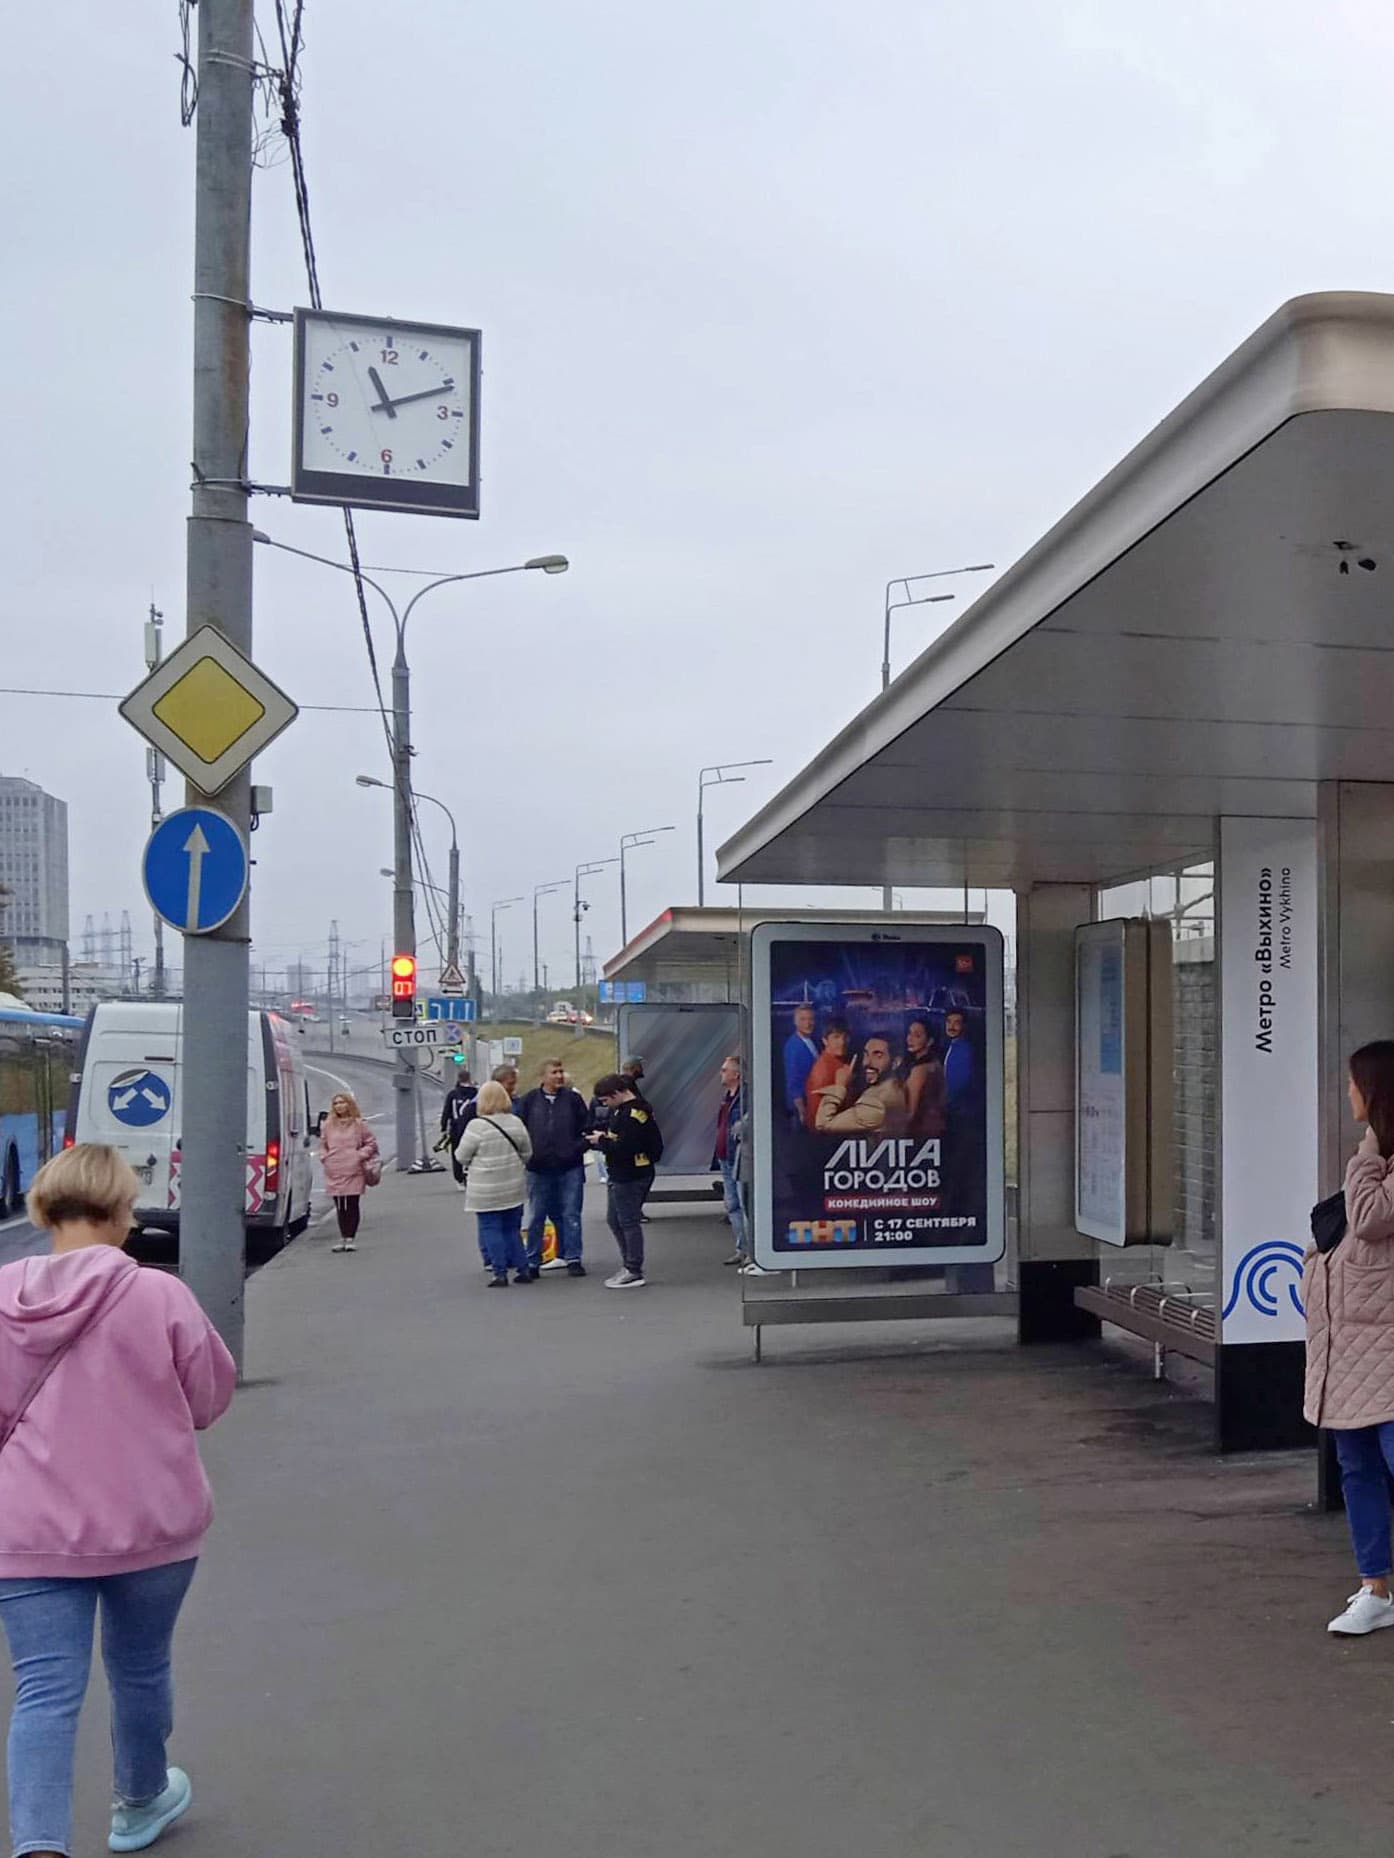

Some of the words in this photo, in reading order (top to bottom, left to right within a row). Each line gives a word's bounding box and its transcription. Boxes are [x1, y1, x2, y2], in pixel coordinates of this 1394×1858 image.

[381, 350, 399, 365] 12
[327, 392, 339, 407] 9
[437, 406, 448, 420] 3
[381, 449, 392, 463] 6
[1279, 867, 1293, 923] Vykhino
[1255, 867, 1273, 974] «Выхино»
[1280, 926, 1291, 969] Metro
[1255, 980, 1276, 1053] Метро
[392, 1029, 437, 1044] СТОП
[824, 1138, 941, 1169] ЛИГА
[824, 1169, 941, 1192] ГОРОДОВ
[911, 1197, 937, 1207] ШОУ
[874, 1219, 884, 1229] С
[888, 1219, 903, 1229] 17
[906, 1217, 977, 1228] СЕНТЯБРЯ
[789, 1219, 857, 1243] ТНТ
[874, 1230, 913, 1241] 21:00
